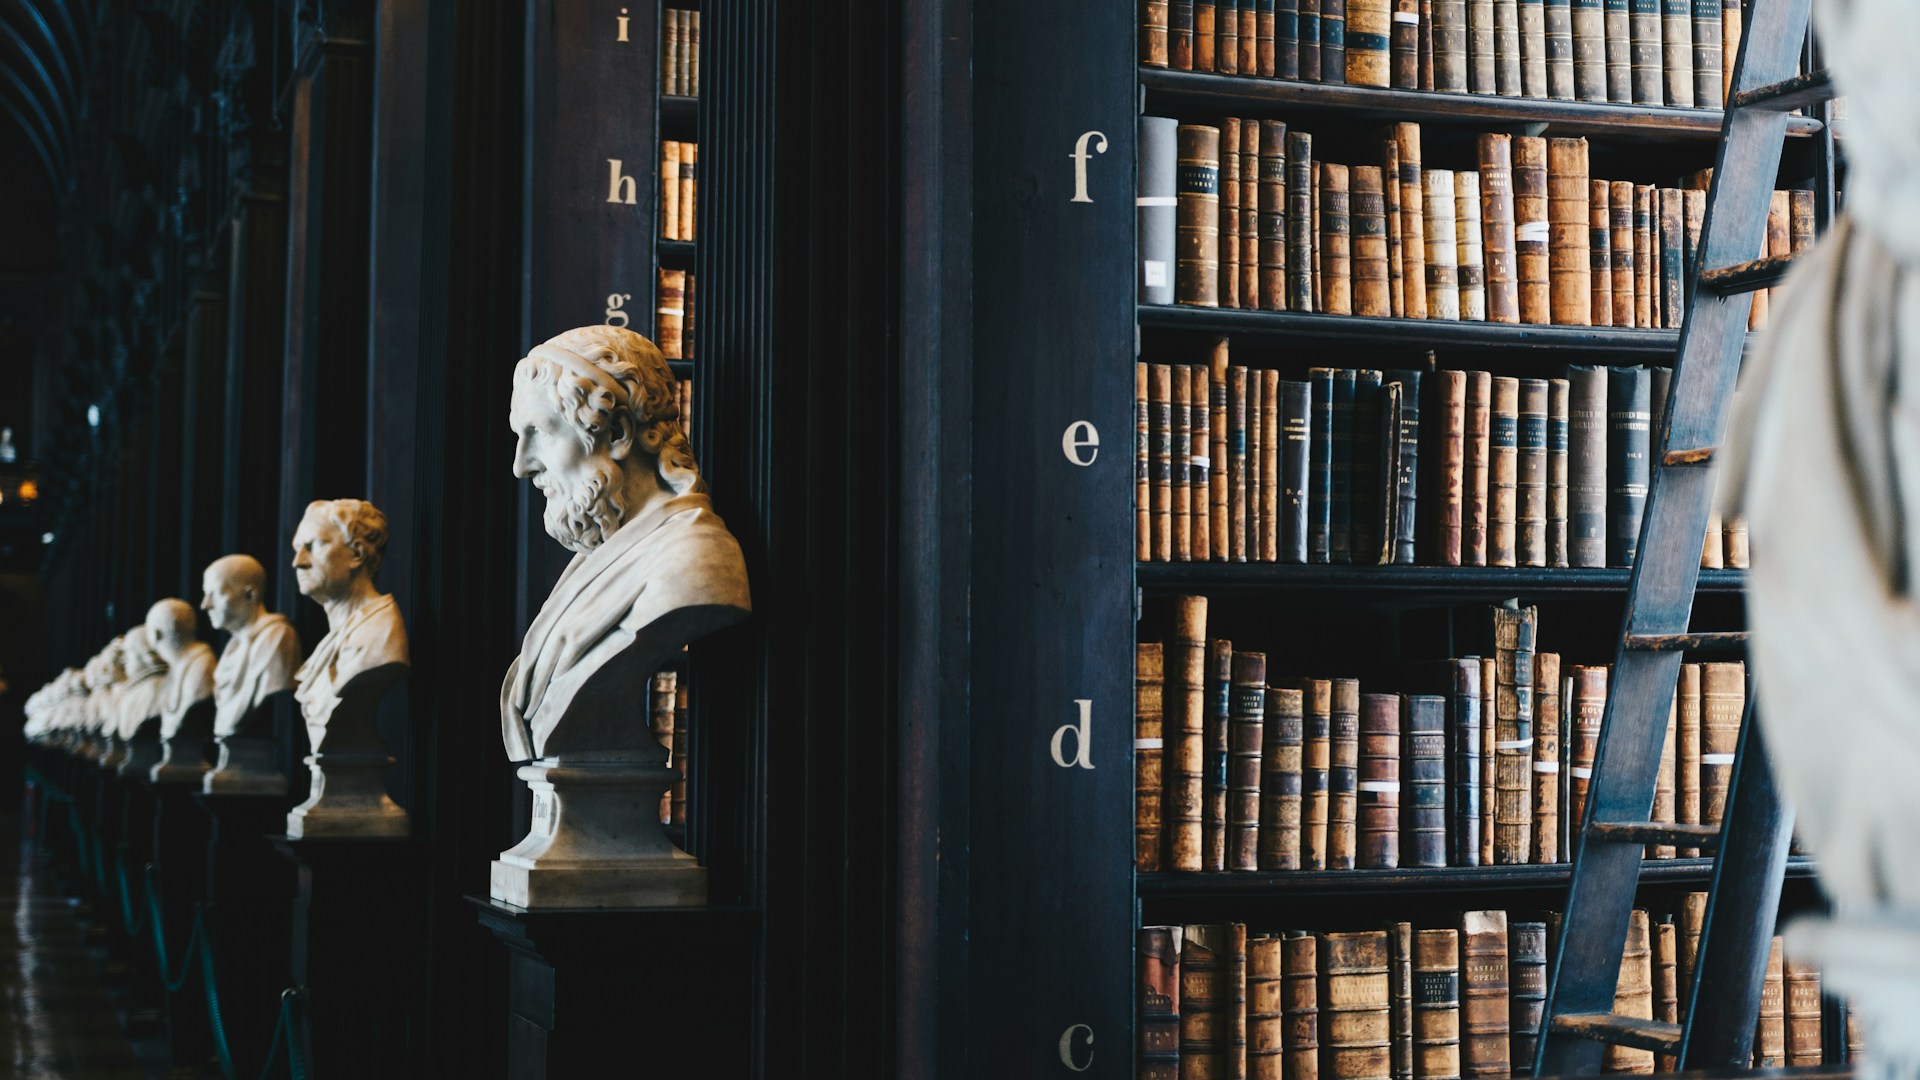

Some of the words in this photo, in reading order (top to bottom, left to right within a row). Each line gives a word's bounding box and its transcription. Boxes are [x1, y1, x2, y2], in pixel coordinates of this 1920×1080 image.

[616, 7, 630, 42] i
[606, 158, 637, 205] h
[1068, 130, 1109, 203] f
[605, 293, 632, 326] g
[1061, 420, 1100, 467] e
[1577, 717, 1601, 726] BIBL
[1581, 706, 1603, 715] HOLY
[1050, 699, 1096, 770] d
[534, 794, 548, 818] Plato
[1473, 974, 1500, 982] OPERA
[1059, 1023, 1095, 1072] c
